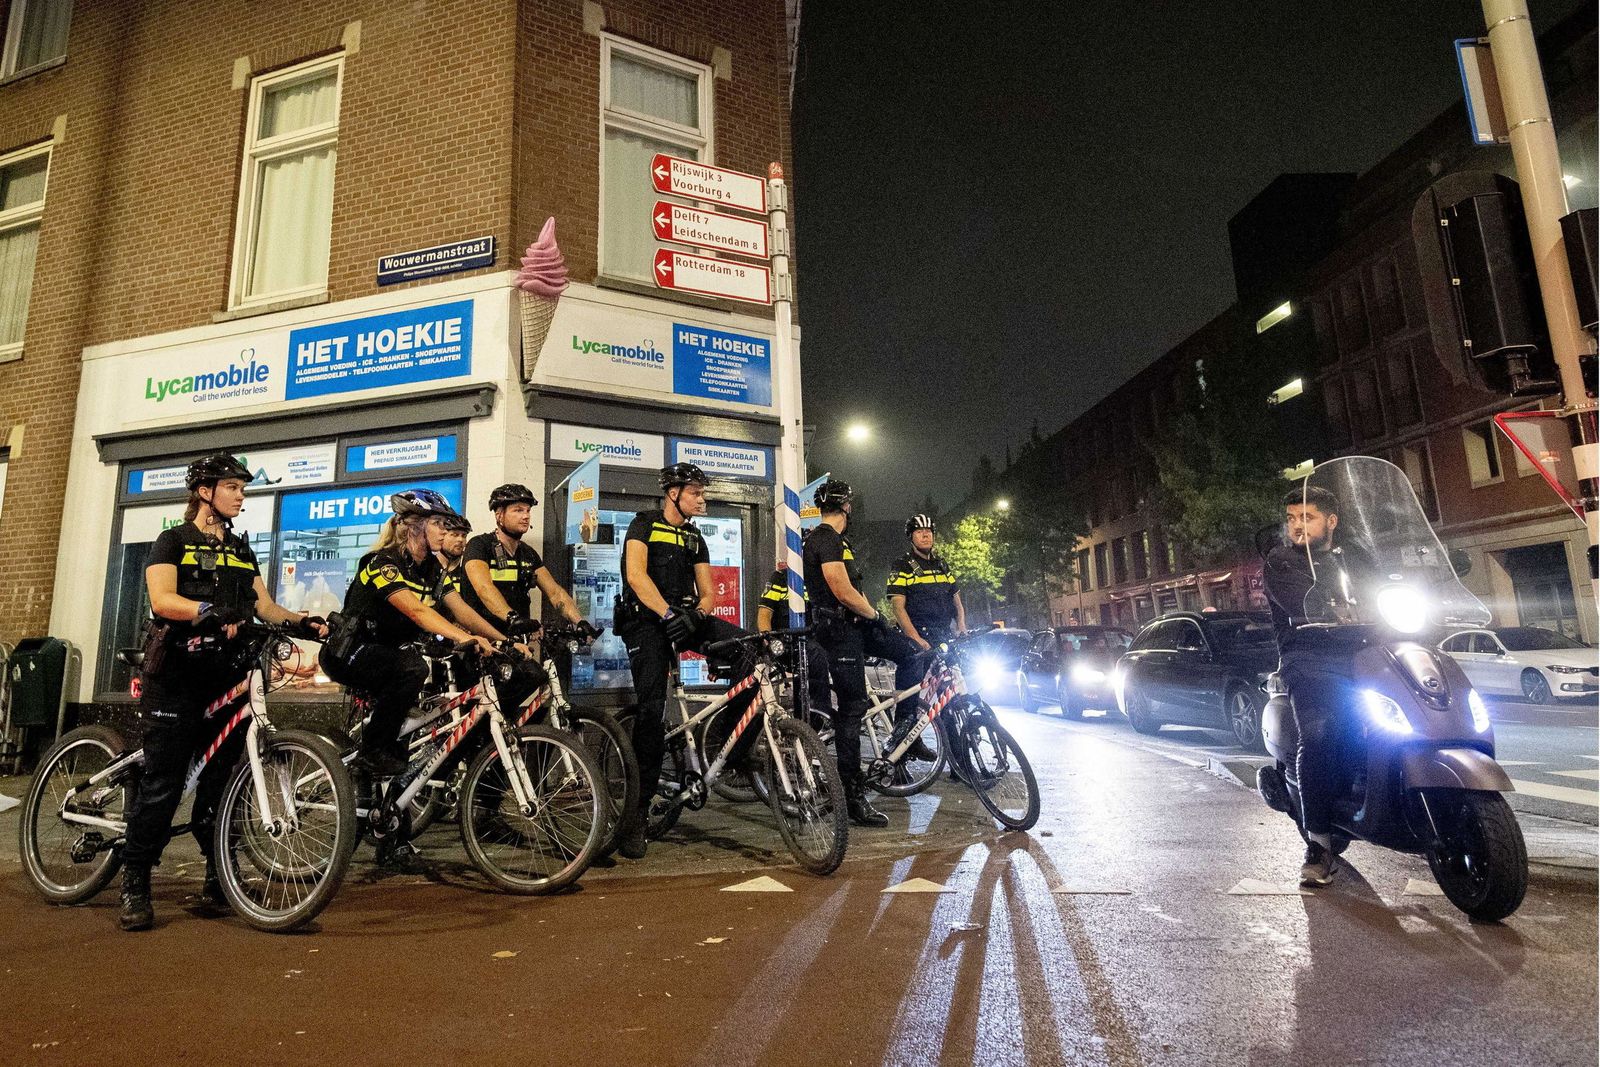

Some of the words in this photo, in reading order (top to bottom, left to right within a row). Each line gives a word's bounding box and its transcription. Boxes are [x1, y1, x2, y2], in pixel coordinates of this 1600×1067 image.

[672, 162, 714, 181] Rijswijk
[717, 174, 723, 182] 3
[673, 178, 722, 199] Voorburg
[725, 191, 731, 199] 4
[674, 209, 701, 223] Delft
[674, 225, 749, 248] Leidschendam
[752, 242, 758, 250] 8
[384, 240, 486, 270] Wouwermanstraat
[675, 256, 732, 275] Rotterdam
[734, 269, 745, 278] 18
[296, 336, 349, 367] HET
[356, 317, 462, 357] HOEKIE
[572, 335, 665, 363] Lycamobile
[678, 331, 708, 347] HET
[712, 337, 765, 357] HOEKIE
[295, 370, 348, 384] LEVENSMIDDELEN
[352, 361, 414, 376] TELEFOONKAARTEN
[419, 354, 462, 366] SIMKAARTEN
[296, 365, 329, 376] ALGEMENE
[330, 361, 357, 371] VOEDING
[362, 358, 374, 367] ICE
[378, 353, 410, 364] DRANKEN
[415, 345, 461, 359] SNOEPWAREN
[145, 360, 270, 402] Lycamobile
[193, 394, 207, 403] Call
[207, 393, 220, 401] the
[220, 388, 241, 399] world
[241, 387, 252, 396] for
[252, 385, 268, 394] less
[370, 447, 385, 456] HIER
[386, 444, 432, 455] VERKRIJGBAAR
[575, 439, 642, 456] Lycamobile
[684, 447, 703, 457] HIER
[704, 449, 759, 462] VERKRIJGBAAR
[374, 456, 395, 464] PREPAID
[395, 453, 428, 462] SIMKAARTEN
[689, 458, 715, 467] PREPAID
[716, 461, 755, 471] SIMKAARTEN
[309, 498, 348, 519] HET
[718, 583, 725, 595] 3
[903, 719, 927, 745] POLITIE
